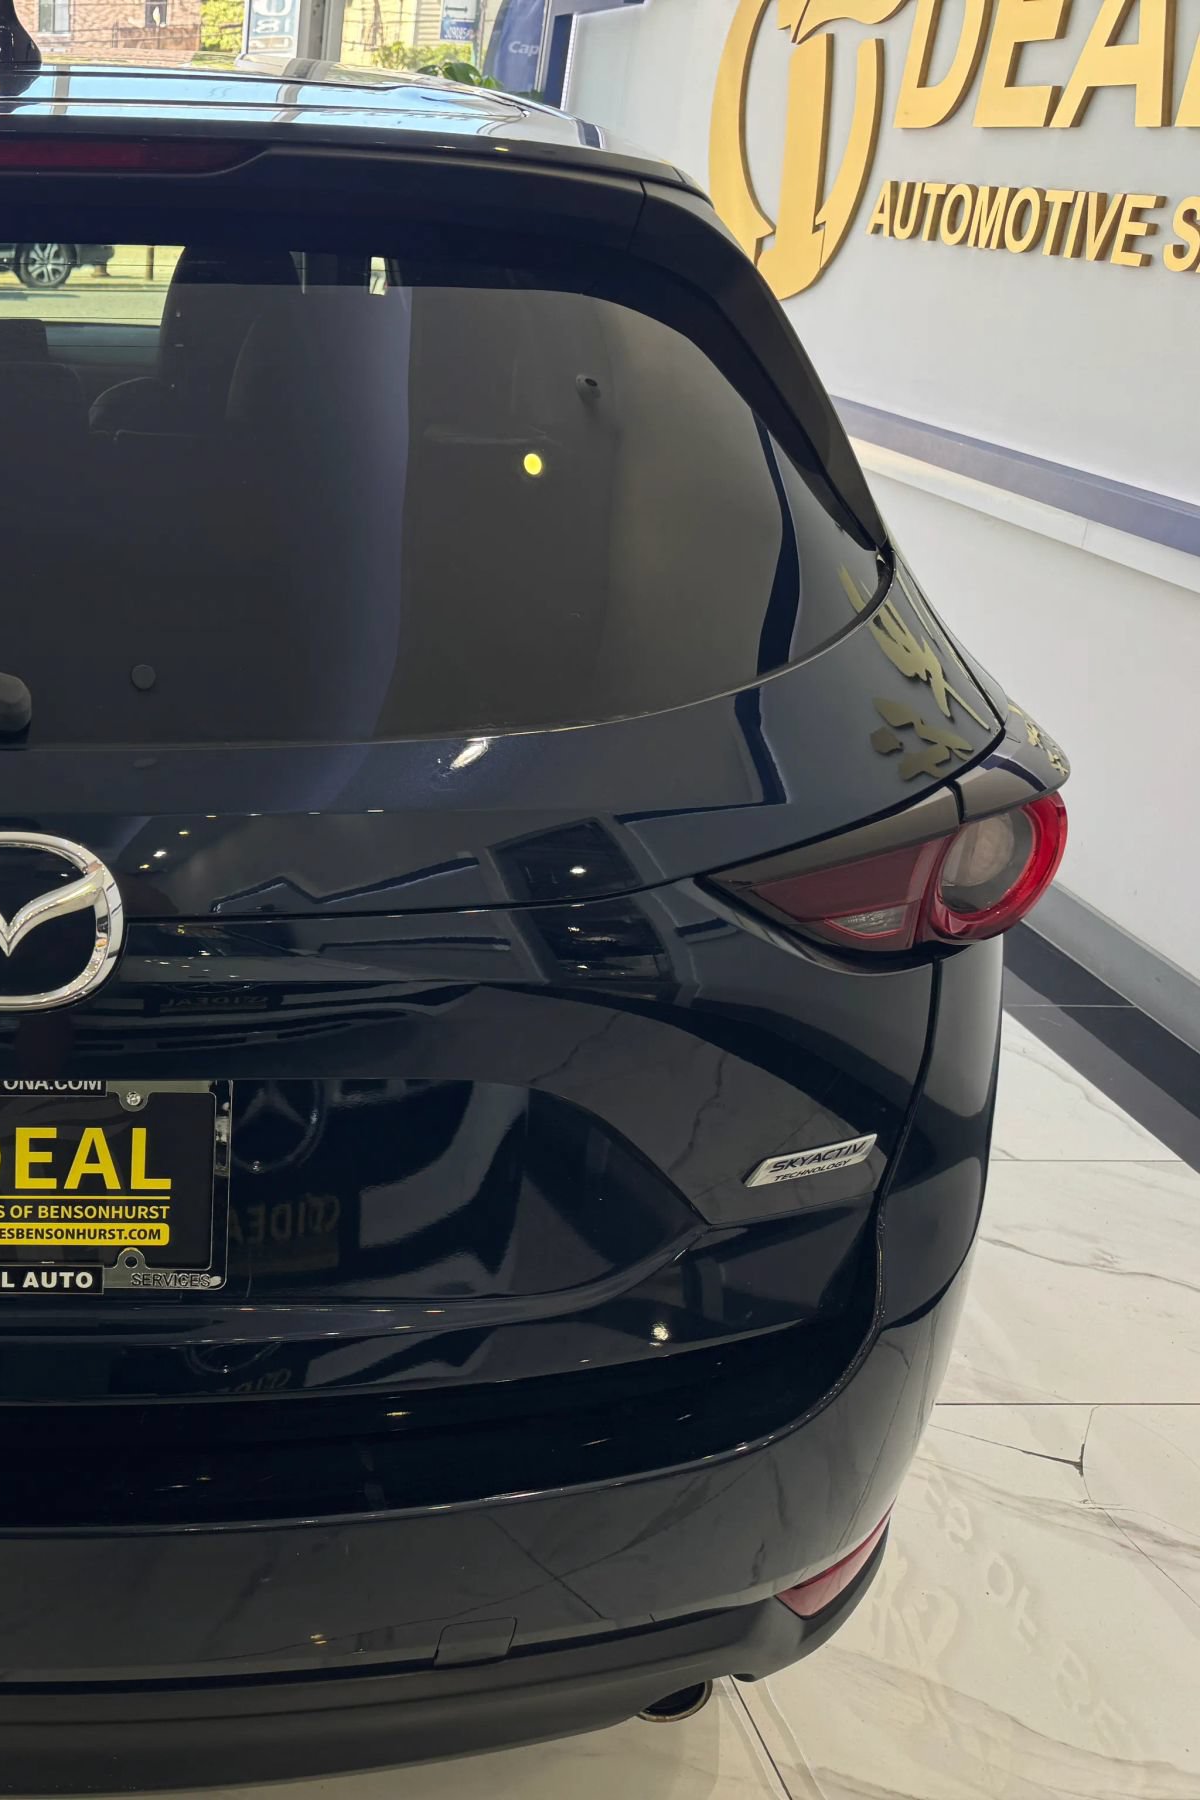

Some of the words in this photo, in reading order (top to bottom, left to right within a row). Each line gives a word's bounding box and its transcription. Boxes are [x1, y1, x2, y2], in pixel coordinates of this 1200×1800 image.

[864, 180, 1167, 268] AUTOMOTIVE
[768, 1141, 866, 1174] SKYACTIV
[774, 1159, 853, 1182] TECHNOLOGY
[9, 1204, 33, 1219] OF
[37, 1205, 171, 1220] BENSONHURST
[23, 1271, 94, 1288] AUTO
[131, 1273, 211, 1288] SERVICES
